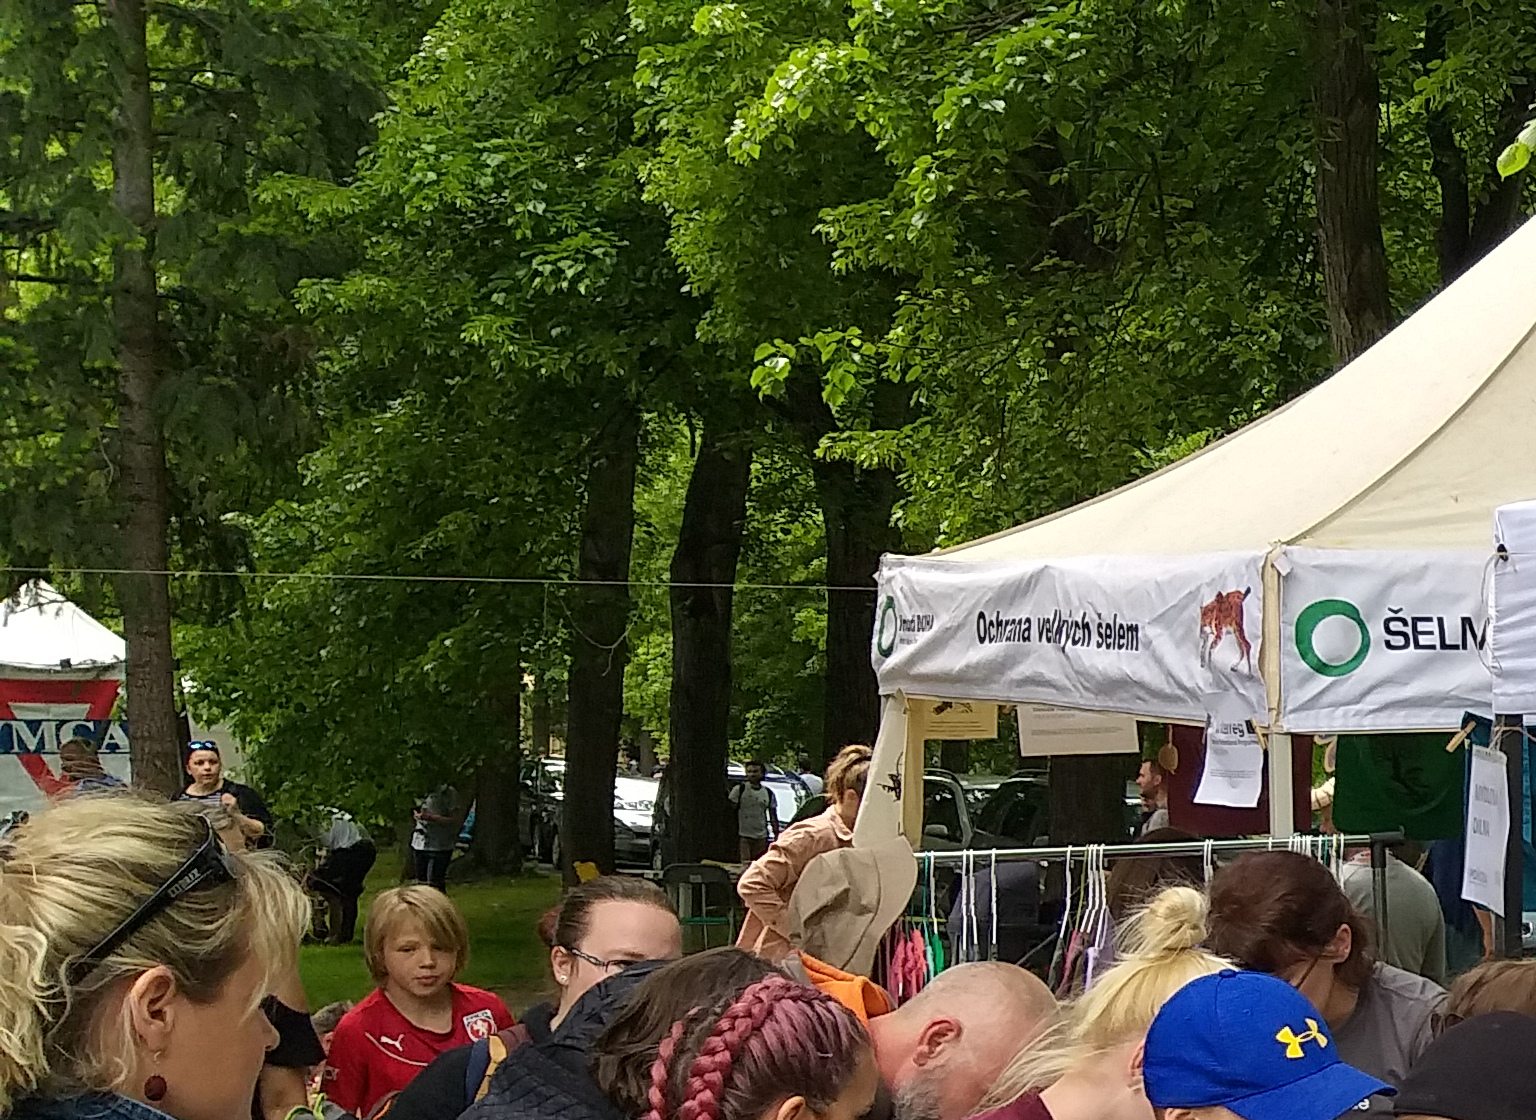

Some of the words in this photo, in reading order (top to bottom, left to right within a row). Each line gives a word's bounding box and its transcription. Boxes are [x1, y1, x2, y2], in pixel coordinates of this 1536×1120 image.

[976, 610, 1032, 645] Ochrana
[1037, 609, 1092, 653] velkých
[1096, 613, 1139, 651] šelem
[0, 720, 131, 754] MCA
